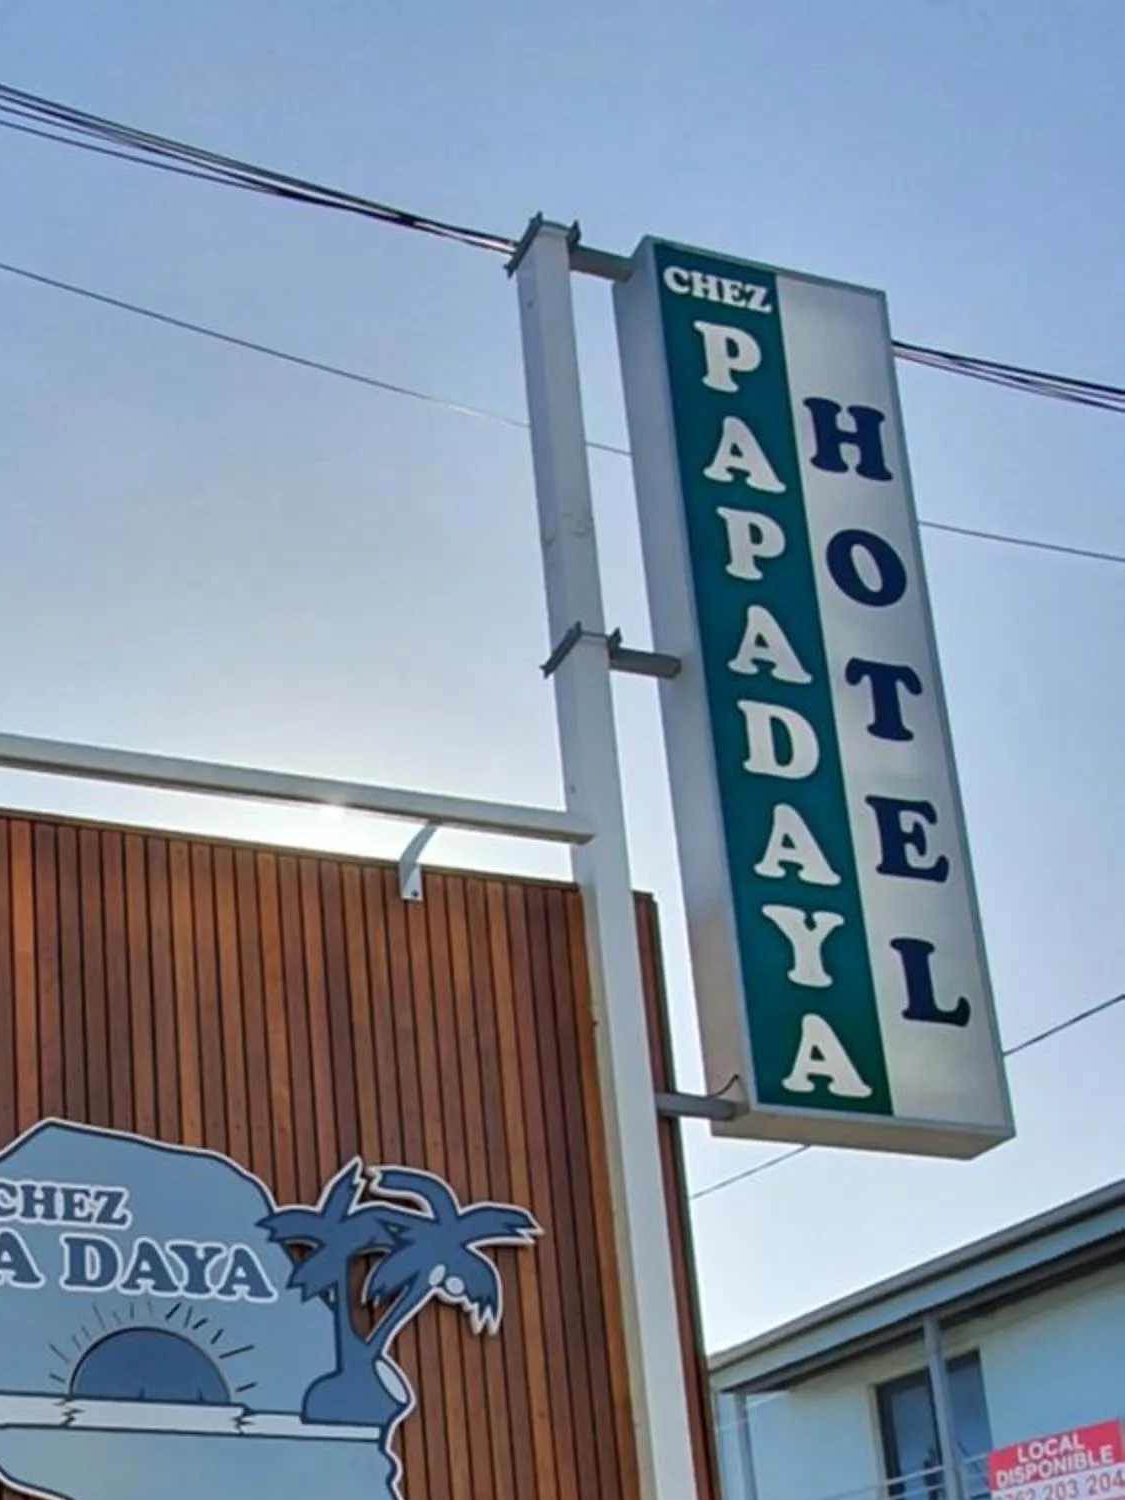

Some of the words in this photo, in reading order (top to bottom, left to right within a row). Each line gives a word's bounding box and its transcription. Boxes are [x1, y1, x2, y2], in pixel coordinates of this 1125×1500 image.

[663, 265, 772, 313] CHEZ
[802, 396, 971, 1028] HOTEL
[60, 1235, 279, 1303] DAYA
[995, 1444, 1115, 1490] DISPONIBLE
[1017, 1433, 1086, 1464] LOCAL
